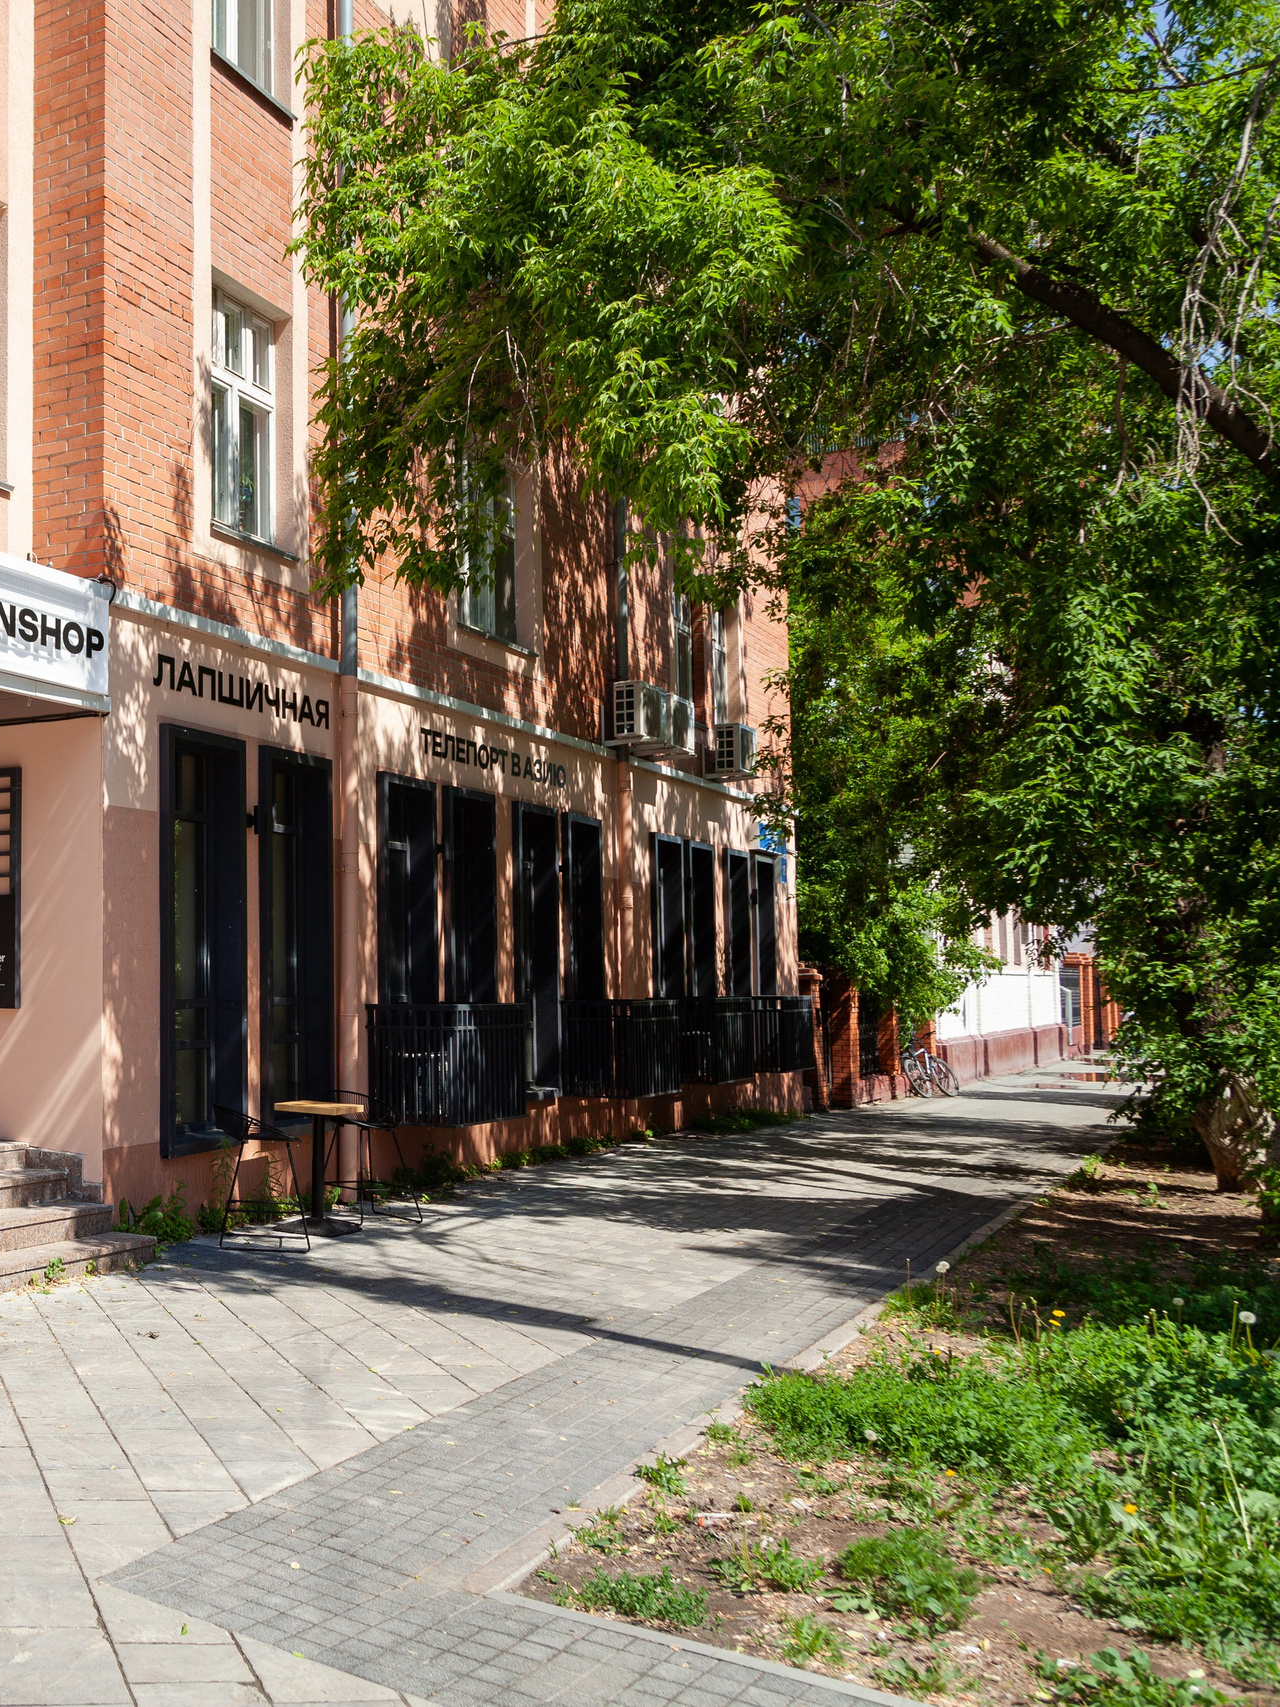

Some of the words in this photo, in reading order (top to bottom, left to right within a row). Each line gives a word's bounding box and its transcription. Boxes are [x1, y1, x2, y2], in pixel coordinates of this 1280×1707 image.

[153, 653, 330, 730] ЛАПШИЧНАЯ
[421, 727, 498, 774] ТЕЛЕПОРТ
[511, 752, 521, 777] В
[523, 756, 566, 788] АЗИЮ
